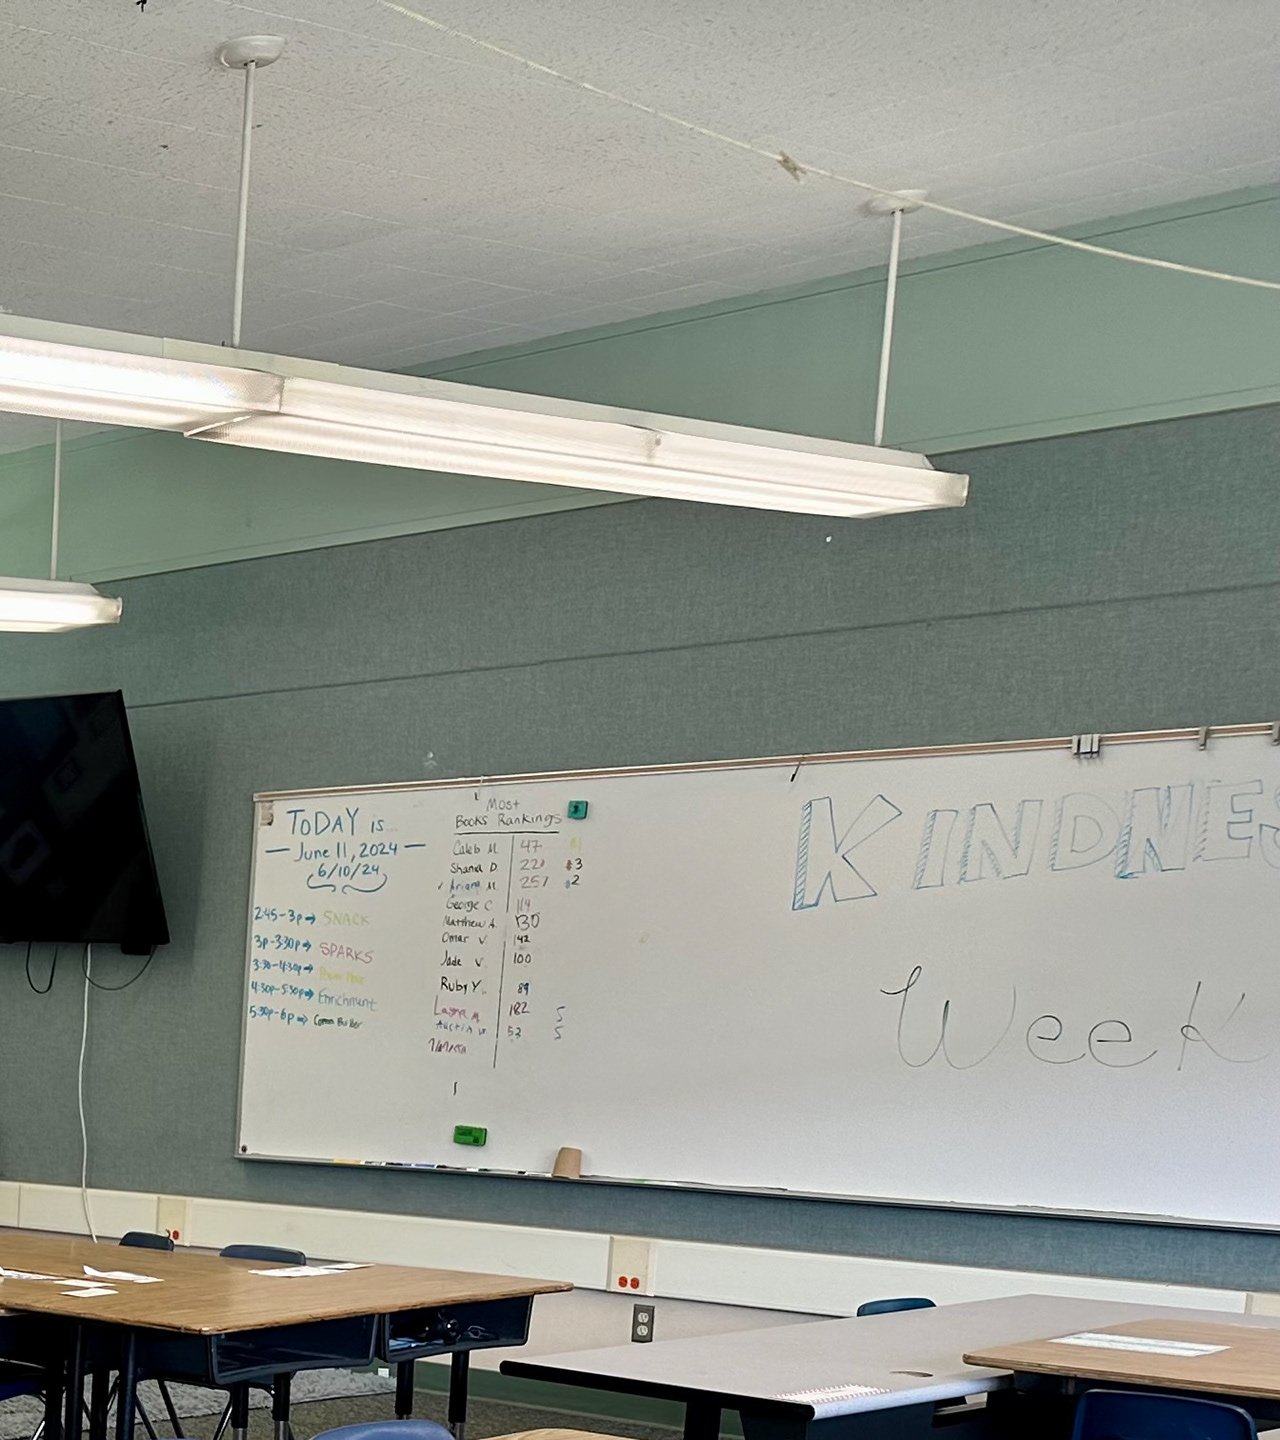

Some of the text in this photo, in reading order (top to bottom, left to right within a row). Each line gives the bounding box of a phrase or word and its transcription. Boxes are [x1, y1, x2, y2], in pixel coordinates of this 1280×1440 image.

[454, 812, 564, 831] Books Rankings
[292, 841, 331, 863] June
[357, 842, 399, 859] 2024
[451, 837, 482, 857] Caleb
[316, 861, 381, 881] 6/10/24
[489, 863, 499, 873] D
[322, 911, 373, 929] SNACK
[318, 942, 376, 965] SPARKS
[439, 949, 463, 968] Jade
[512, 951, 533, 965] 100
[439, 975, 469, 996] Ruby
[878, 964, 1272, 1073] Week
